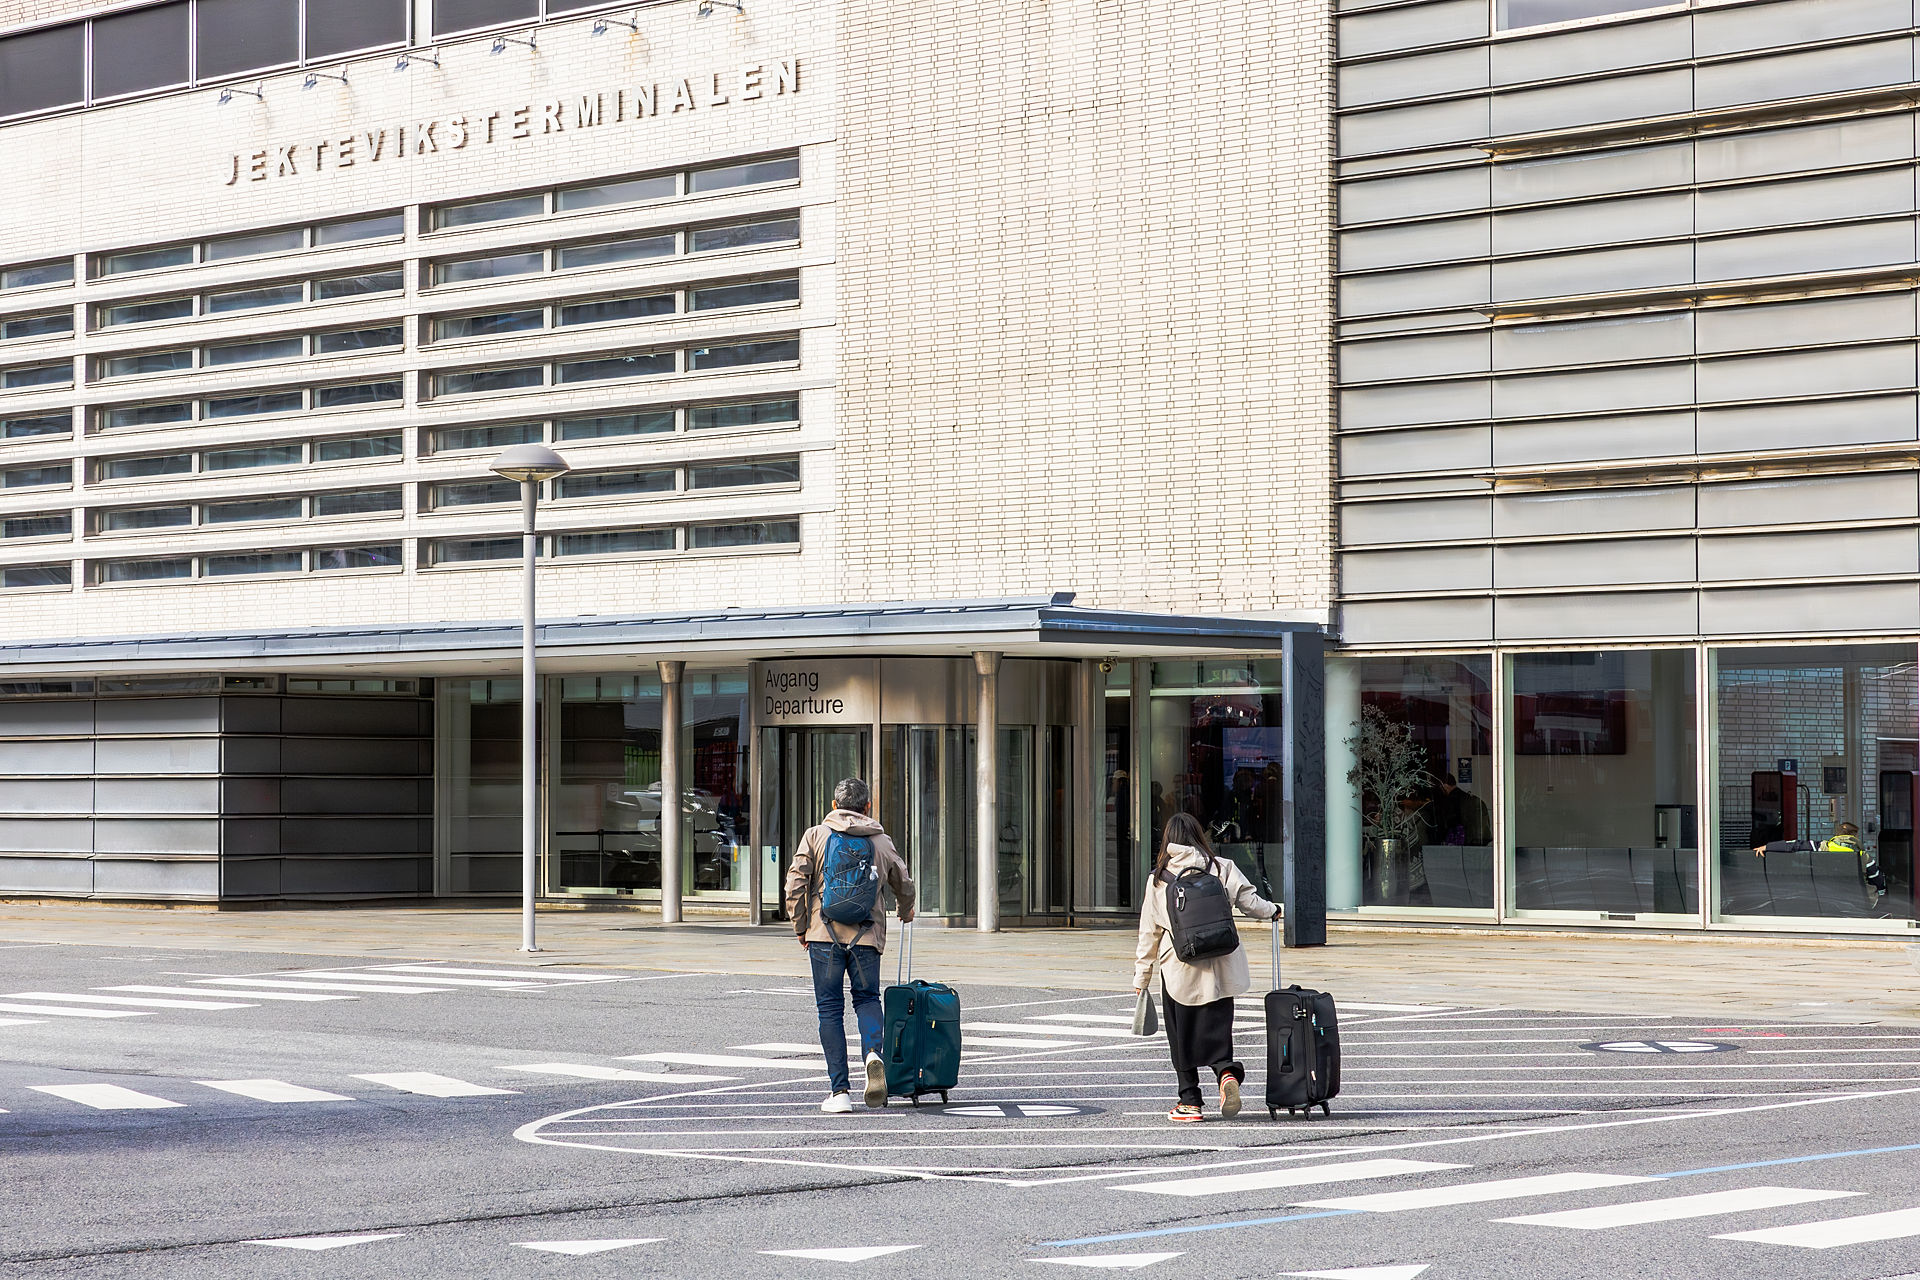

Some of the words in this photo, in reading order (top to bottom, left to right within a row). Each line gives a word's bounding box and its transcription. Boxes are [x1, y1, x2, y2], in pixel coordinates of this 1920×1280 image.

[226, 58, 802, 186] JEKTEVIKSTERMINALEN
[765, 669, 818, 692] Avgang
[765, 696, 844, 719] Departure
